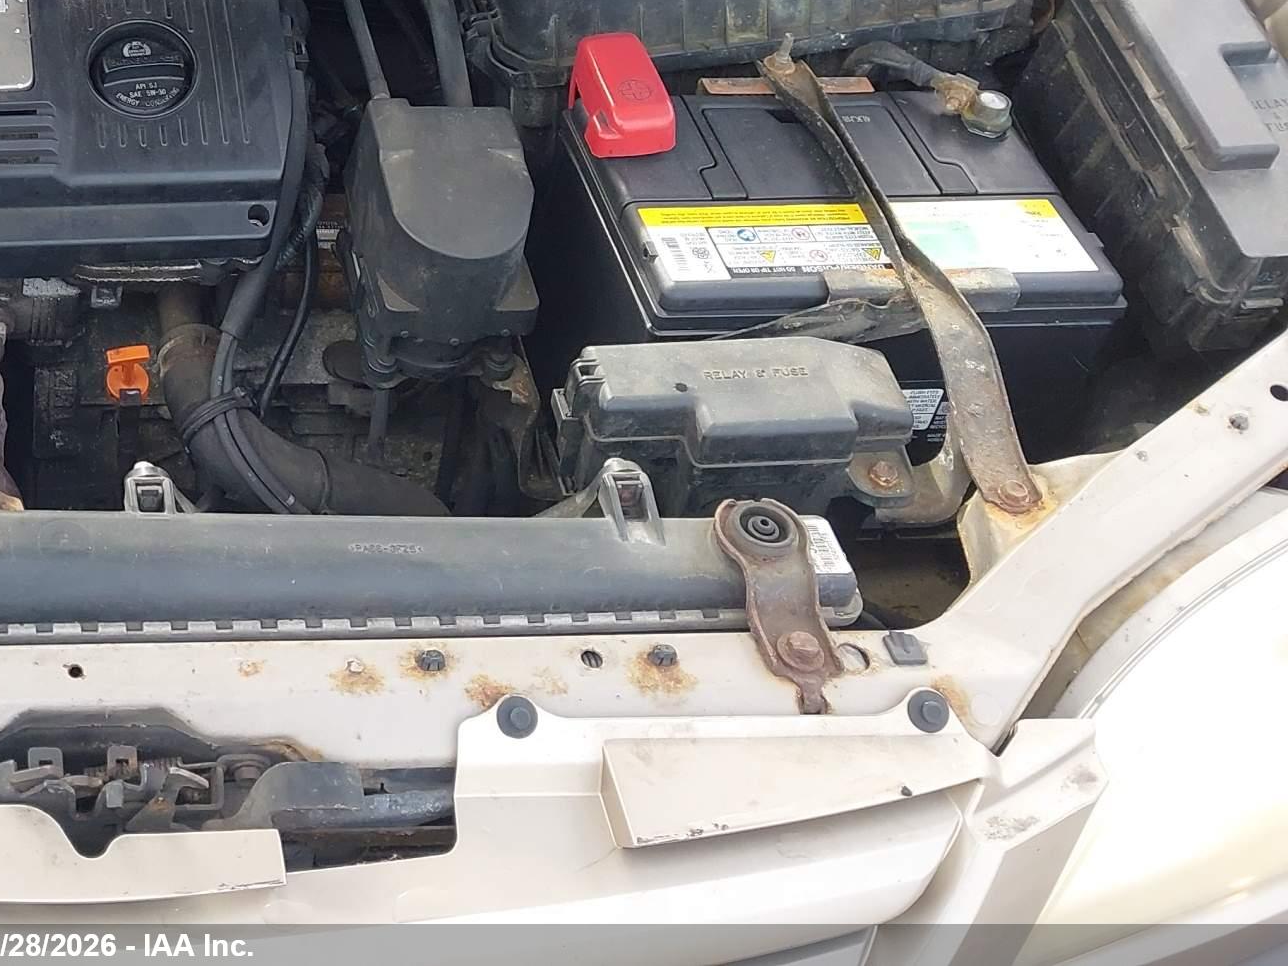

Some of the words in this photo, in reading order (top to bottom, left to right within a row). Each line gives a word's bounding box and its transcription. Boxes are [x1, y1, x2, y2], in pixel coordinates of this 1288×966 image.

[115, 92, 140, 106] ENERGY
[703, 369, 747, 380] RELAY
[755, 368, 766, 378] &
[772, 366, 809, 377] FUSE
